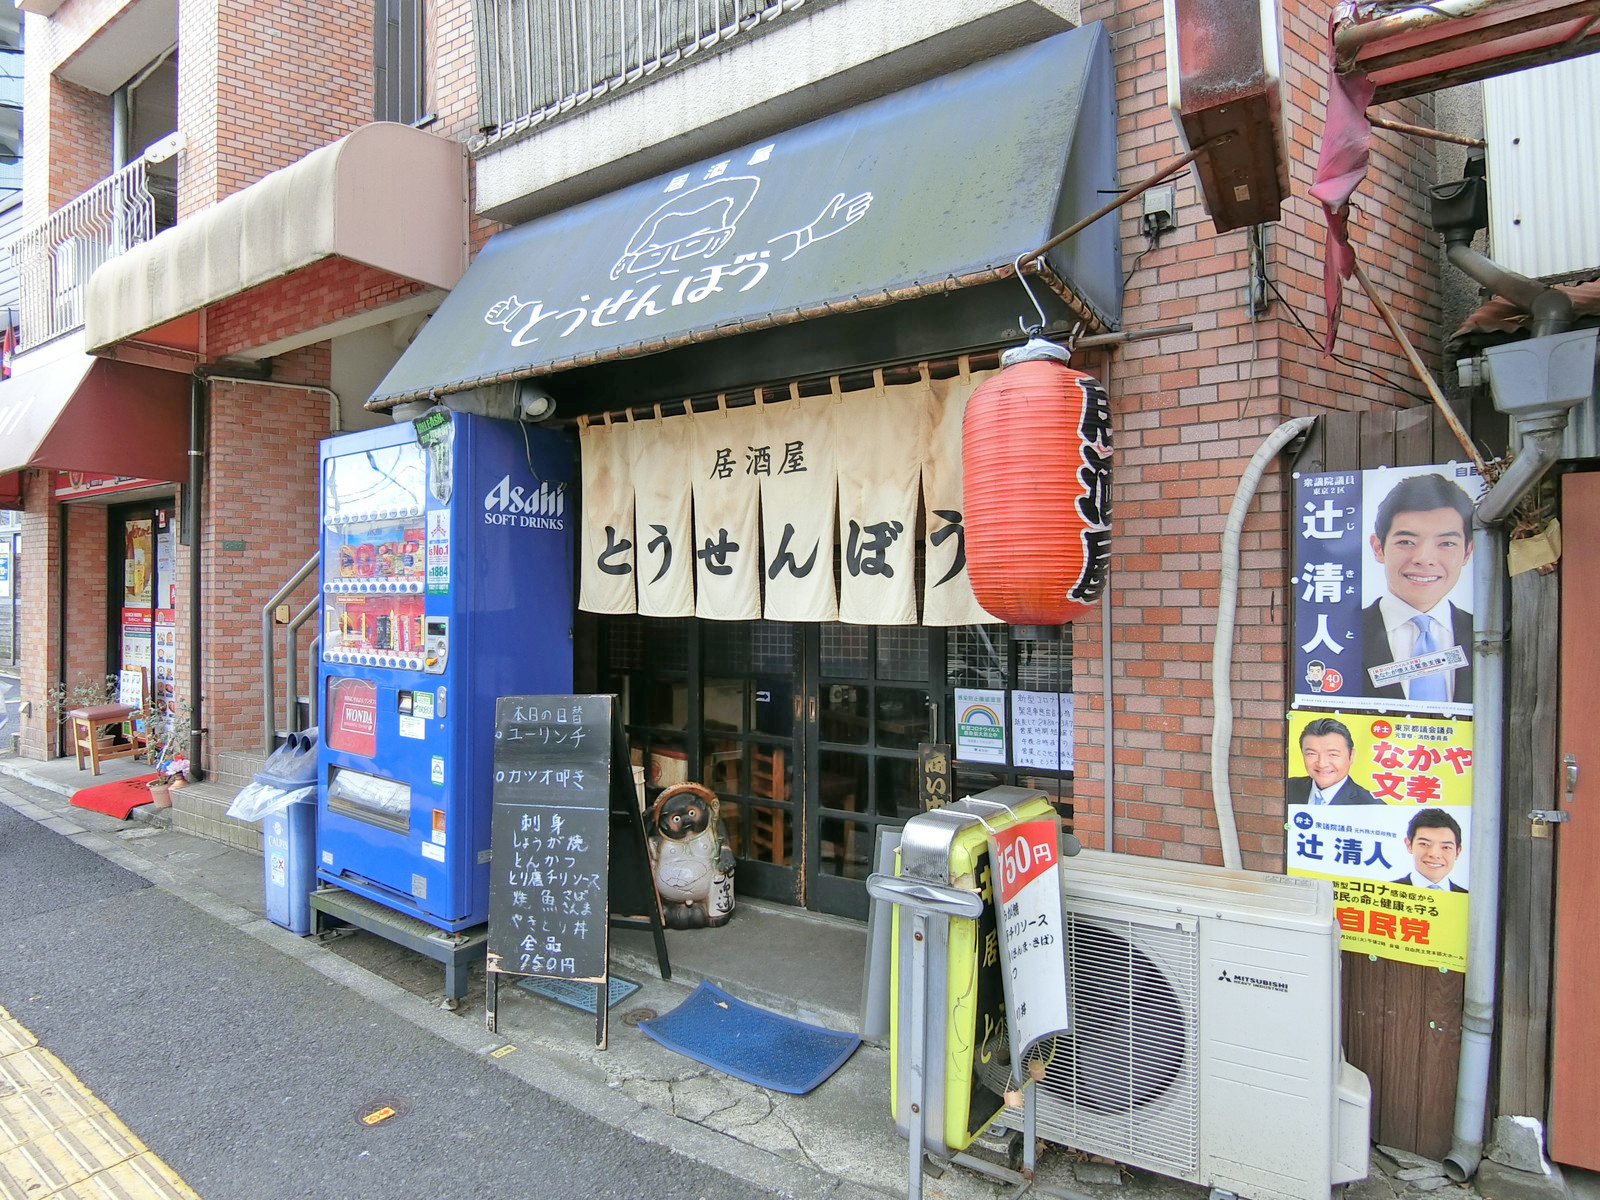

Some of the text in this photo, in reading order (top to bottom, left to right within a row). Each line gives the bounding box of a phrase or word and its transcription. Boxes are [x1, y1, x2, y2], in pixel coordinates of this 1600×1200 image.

[664, 143, 776, 194] 居酒屋
[511, 250, 770, 347] とうせんぼう
[710, 440, 808, 480] 居酒屋
[1303, 475, 1355, 488] 衆議院議員
[484, 474, 564, 517] Asahi
[484, 512, 564, 530] SOFT DRINKS
[432, 566, 448, 577] 1884
[1325, 673, 1341, 684] 40
[345, 708, 373, 724] WONDA
[1394, 724, 1453, 735] 東京都議会議員
[1372, 740, 1472, 775] なかや
[1372, 771, 1441, 804] 文孝
[520, 813, 567, 835] 刺身
[1315, 821, 1353, 833] 衆議院議員
[513, 830, 589, 852] しょうが焼
[514, 852, 576, 869] とんかつ
[1336, 906, 1431, 945] 自民党
[520, 934, 562, 952] 全品
[520, 954, 576, 974] 750円
[1233, 974, 1288, 989] MITSUBISHI
[1252, 983, 1289, 993] INDUSTRIES
